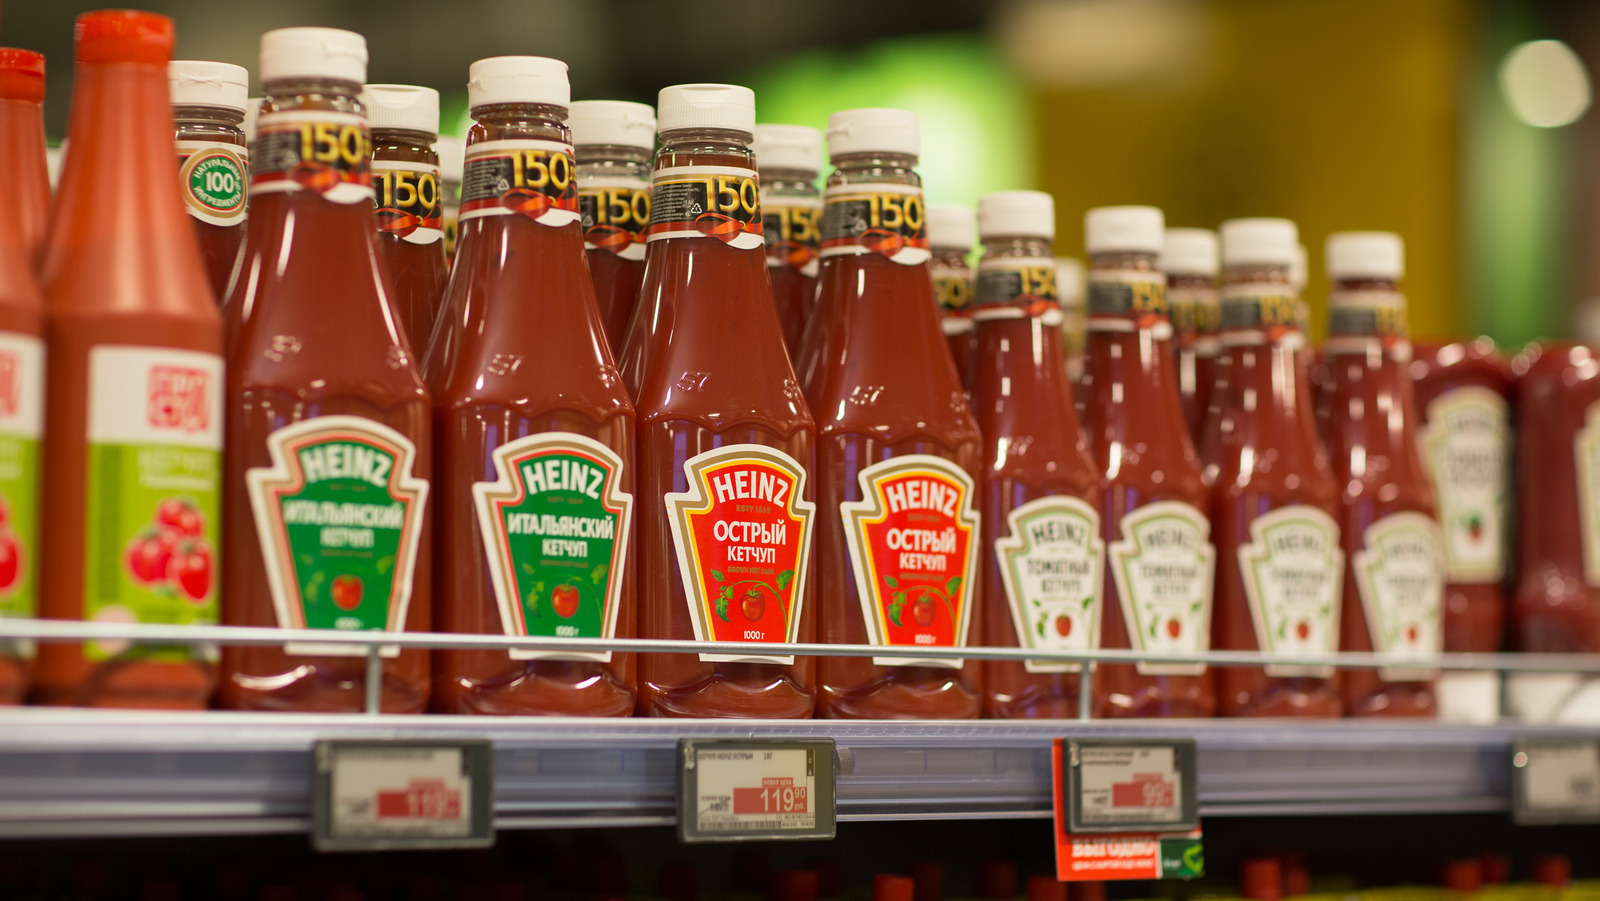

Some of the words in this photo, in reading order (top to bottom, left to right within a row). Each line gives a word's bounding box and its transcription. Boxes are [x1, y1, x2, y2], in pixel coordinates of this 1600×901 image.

[300, 123, 364, 165] 150
[511, 151, 570, 190] 150
[381, 171, 437, 210] 150
[706, 175, 758, 214] 150
[596, 188, 650, 226] 150
[869, 194, 923, 231] 150
[301, 443, 392, 488] HEINZ
[522, 459, 604, 500] HEINZ
[712, 470, 789, 508] HEINZ
[885, 480, 959, 518] HEINZ
[284, 498, 404, 530] ИТАЛЬЯНСКИЙ
[507, 511, 614, 540] ИТАЛЬЯНСКИЙ
[713, 518, 786, 546] ОСТРЫЙ
[886, 527, 957, 554] ОСТРЫЙ
[1031, 520, 1086, 546] HEINZ
[542, 538, 588, 558] КЕТЧУП
[727, 545, 776, 564] КЕТЧУП
[899, 552, 947, 571] КЕТЧУП
[727, 566, 749, 574] GROWN
[749, 566, 760, 575] NOT
[761, 567, 775, 576] MADE
[743, 630, 761, 640] 1000
[760, 788, 794, 812] 119
[795, 787, 806, 799] 90
